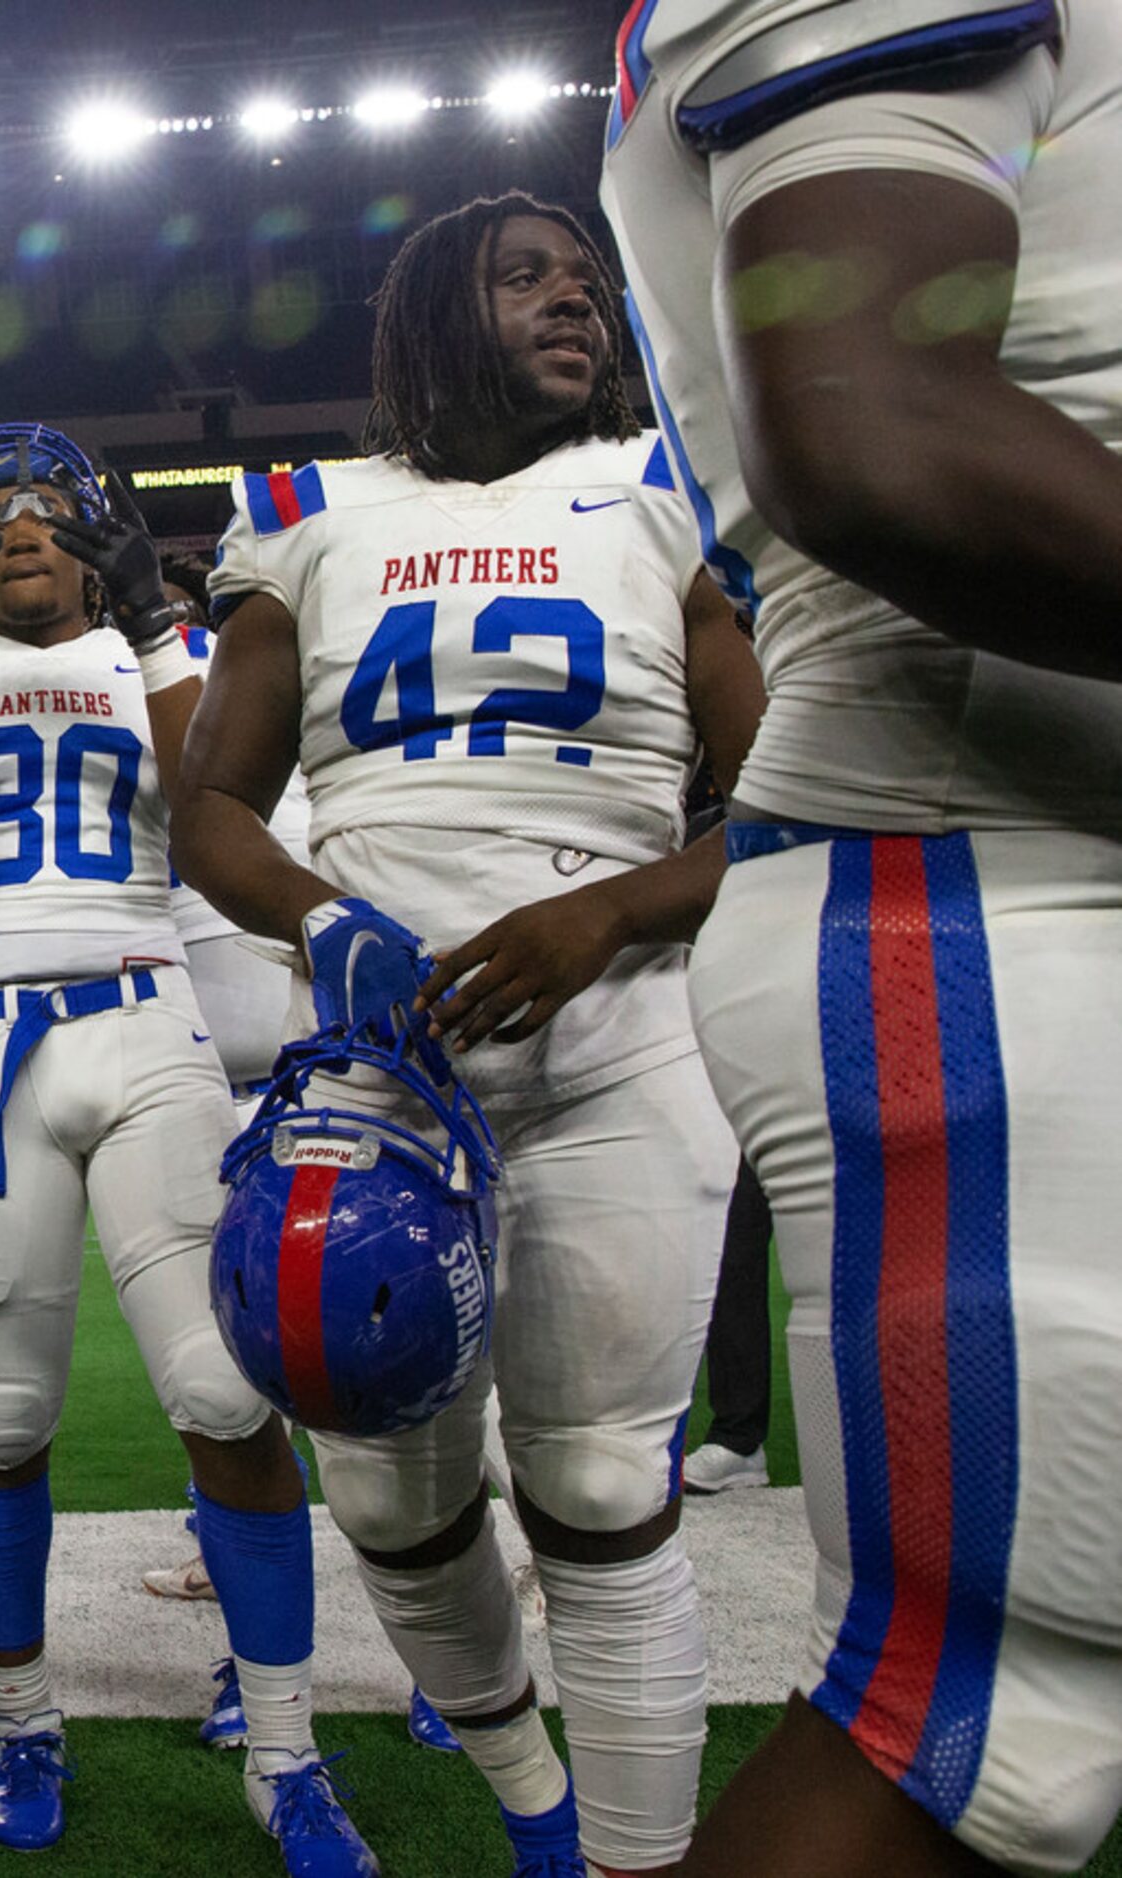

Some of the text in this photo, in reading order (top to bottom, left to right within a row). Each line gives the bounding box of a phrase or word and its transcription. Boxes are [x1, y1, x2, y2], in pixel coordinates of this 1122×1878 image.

[131, 466, 244, 490] WHATABURGER
[380, 546, 559, 595] PANTHERS
[339, 595, 606, 767] 42
[294, 1147, 352, 1164] Riddell
